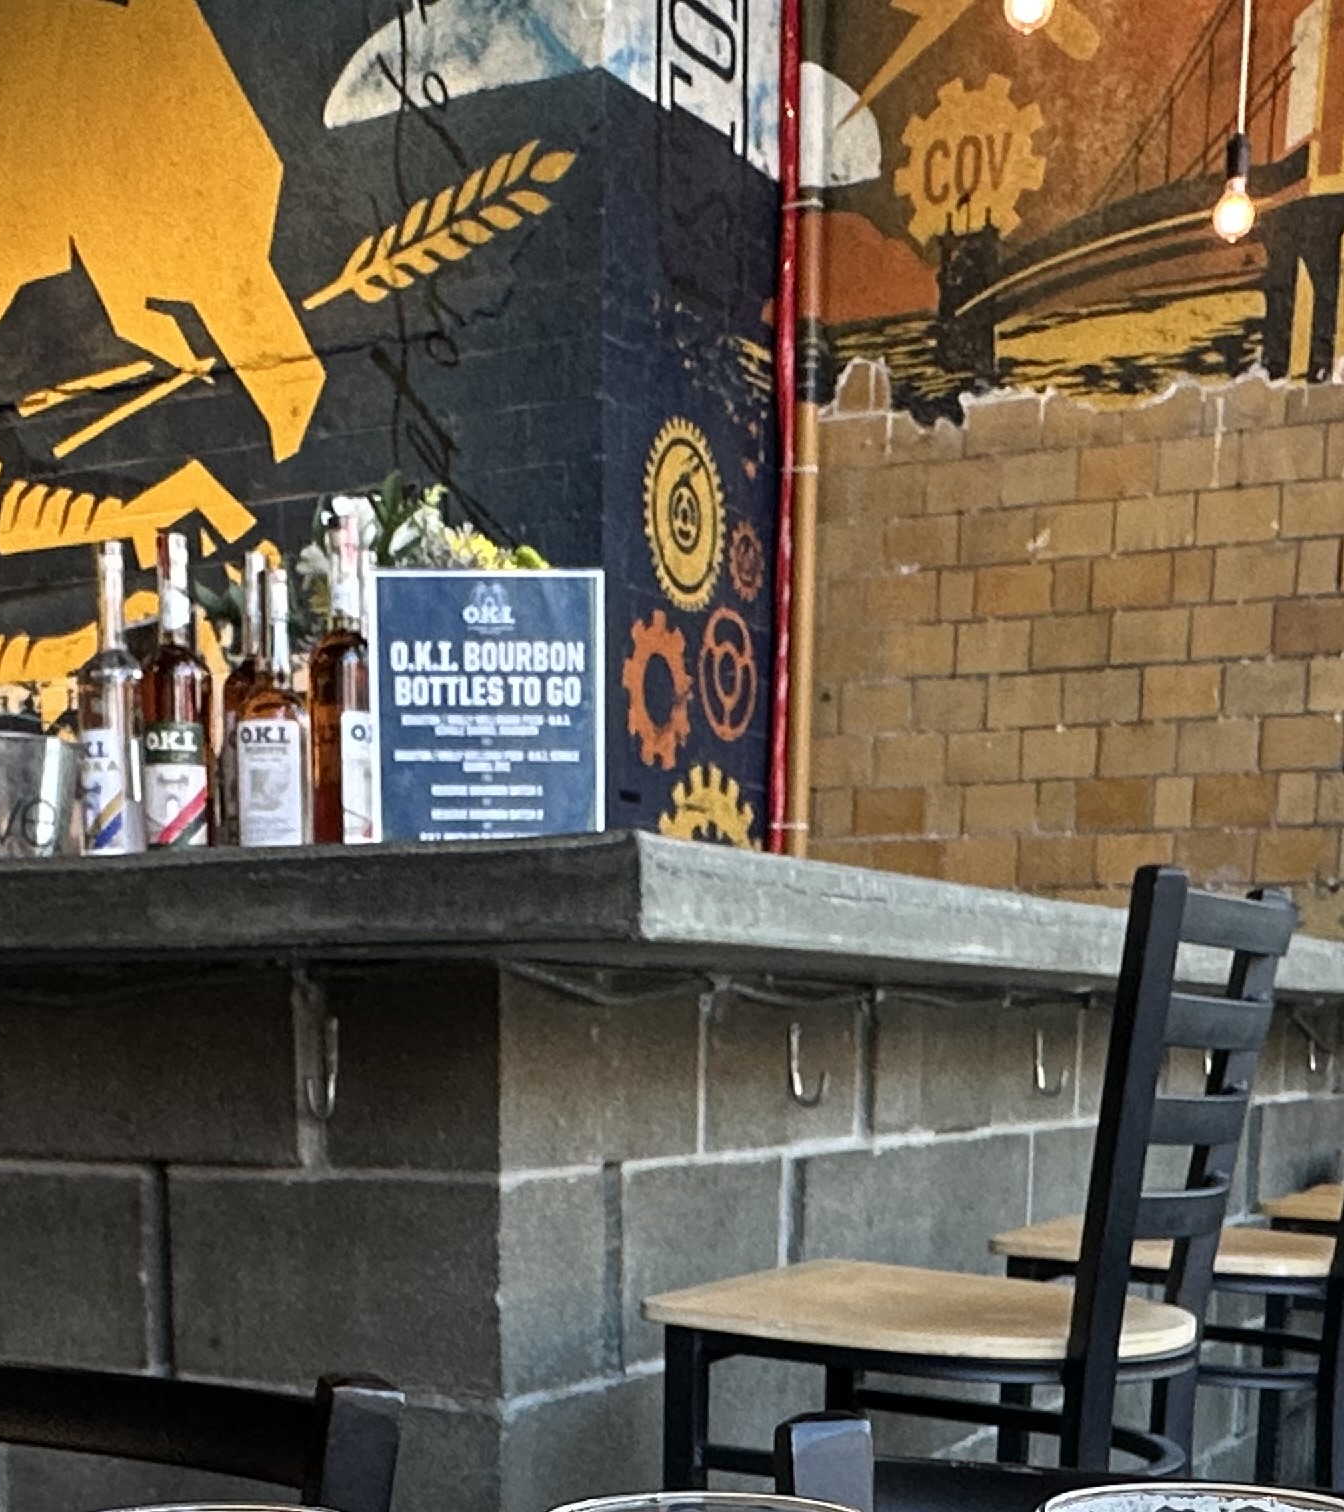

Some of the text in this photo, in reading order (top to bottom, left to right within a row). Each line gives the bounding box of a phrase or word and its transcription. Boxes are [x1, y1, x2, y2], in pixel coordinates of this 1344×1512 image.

[923, 131, 1013, 204] COV
[390, 640, 585, 673] O.K.I. BOURBON
[394, 676, 582, 707] BOTTLES TO GO
